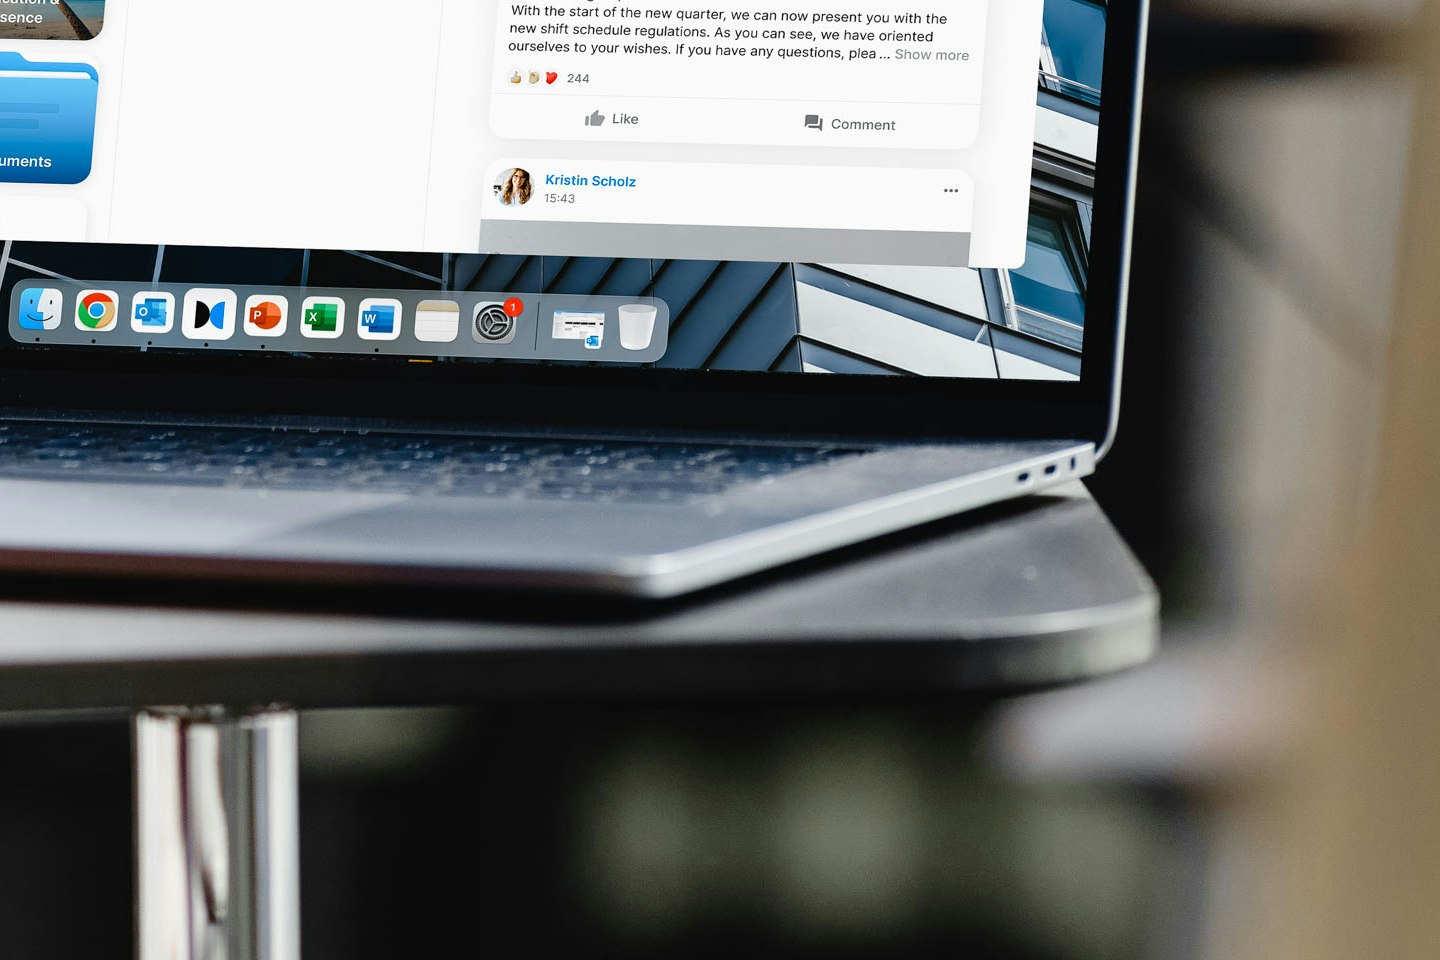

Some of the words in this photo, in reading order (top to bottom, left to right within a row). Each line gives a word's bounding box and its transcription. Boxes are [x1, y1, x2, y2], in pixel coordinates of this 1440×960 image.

[512, 5, 540, 16] With
[545, 6, 565, 16] the
[570, 7, 599, 17] start
[604, 7, 617, 17] of
[621, 8, 641, 18] the
[646, 10, 672, 18] new
[677, 10, 726, 21] quarter,
[731, 12, 749, 20] we
[754, 12, 776, 20] can
[781, 13, 808, 21] now
[813, 13, 862, 24] present
[866, 14, 889, 25] you
[894, 13, 921, 23] with
[926, 14, 947, 24] the
[510, 25, 536, 33] new
[541, 23, 568, 34] shift
[573, 25, 631, 35] schedule
[635, 26, 709, 39] regulations.
[714, 27, 730, 38] As
[735, 30, 758, 40] you
[762, 30, 785, 39] can
[790, 31, 816, 41] see,
[821, 32, 839, 40] we
[844, 30, 874, 41] have
[879, 30, 933, 42] oriented
[509, 41, 569, 52] ourselves
[574, 43, 586, 52] to
[591, 45, 619, 55] your
[624, 43, 670, 54] wishes.
[676, 44, 684, 54] If
[688, 47, 711, 57] you
[716, 45, 746, 56] have
[750, 48, 773, 59] any
[778, 47, 844, 60] questions,
[849, 48, 876, 60] plea
[895, 49, 931, 60] Show
[936, 52, 969, 61] more
[567, 74, 589, 83] 244
[613, 114, 638, 124] Like
[832, 119, 896, 130] Comment
[546, 175, 588, 186] Kristin
[592, 176, 636, 187] Scholz
[545, 194, 575, 203] 15:43
[254, 311, 262, 319] P
[308, 313, 317, 322] X
[364, 314, 376, 323] W
